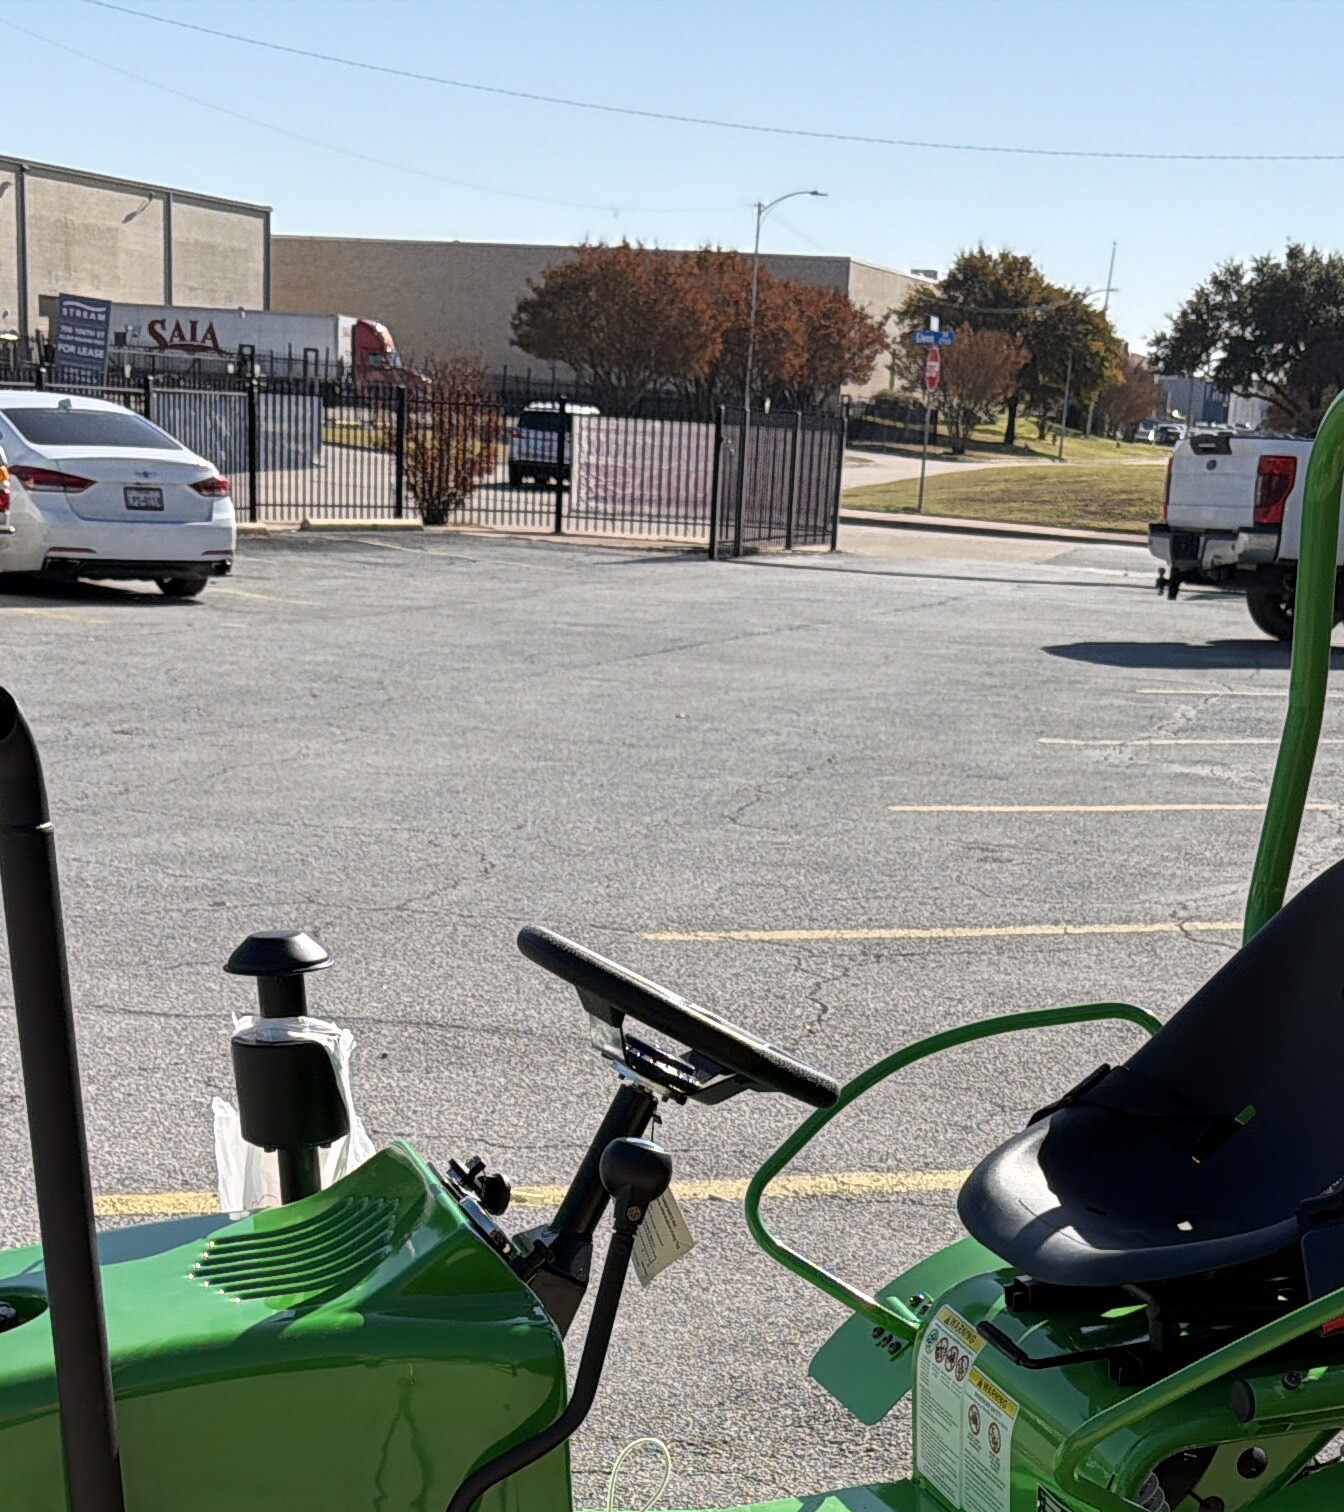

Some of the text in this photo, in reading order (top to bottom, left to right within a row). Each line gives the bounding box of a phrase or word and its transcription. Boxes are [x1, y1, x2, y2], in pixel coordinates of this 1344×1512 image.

[61, 307, 106, 321] STREAM
[57, 343, 105, 359] FOR LEASE
[147, 318, 223, 355] SAIA
[948, 1316, 977, 1345] WARNING
[982, 1380, 1009, 1410] WARNING
